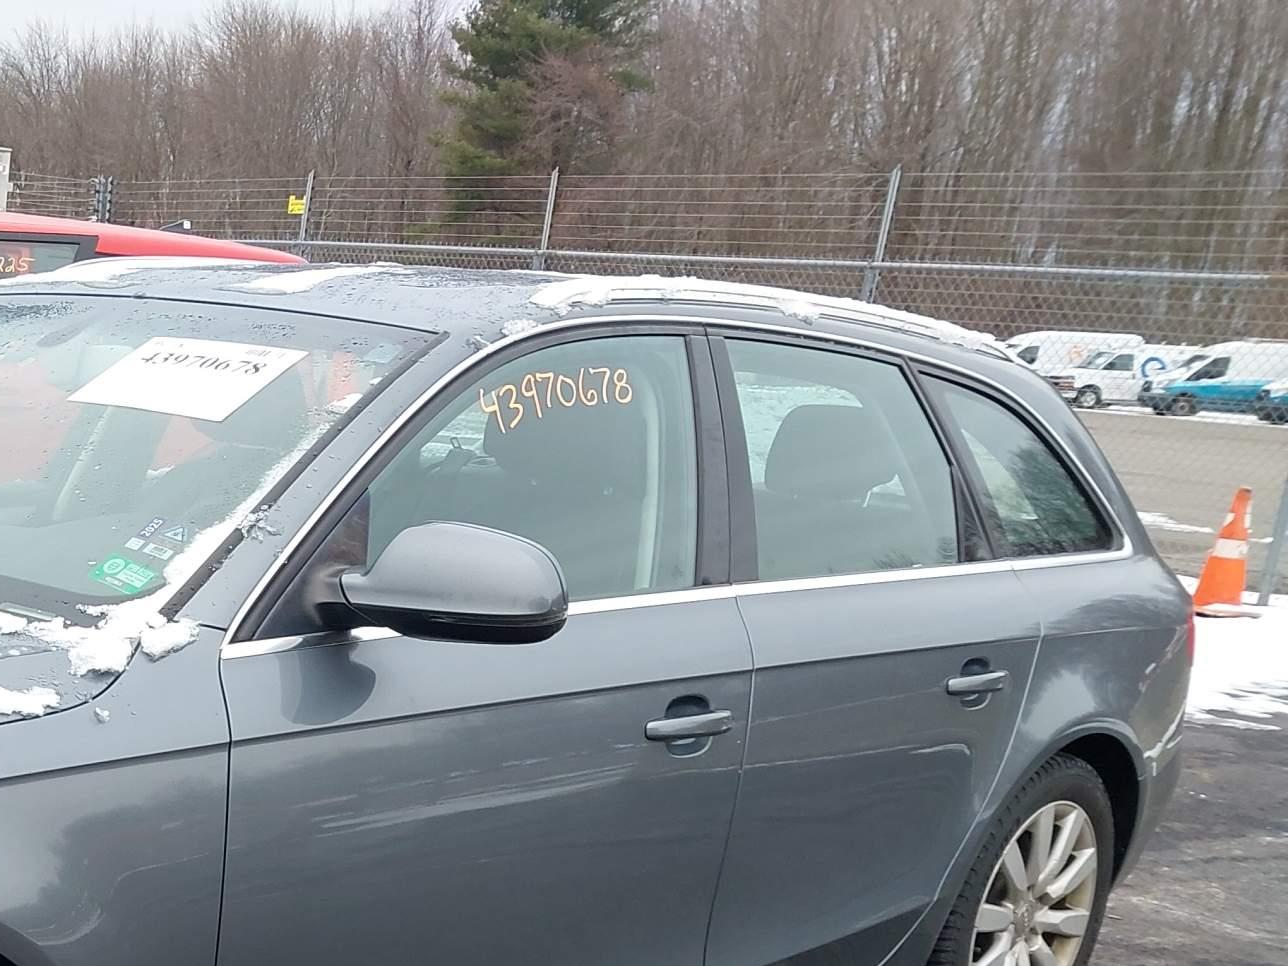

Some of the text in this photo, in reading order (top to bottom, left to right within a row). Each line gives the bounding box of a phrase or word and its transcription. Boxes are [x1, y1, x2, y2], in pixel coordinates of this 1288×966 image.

[141, 352, 267, 375] 43970678
[479, 367, 633, 434] 43970678
[139, 518, 164, 537] 2025
